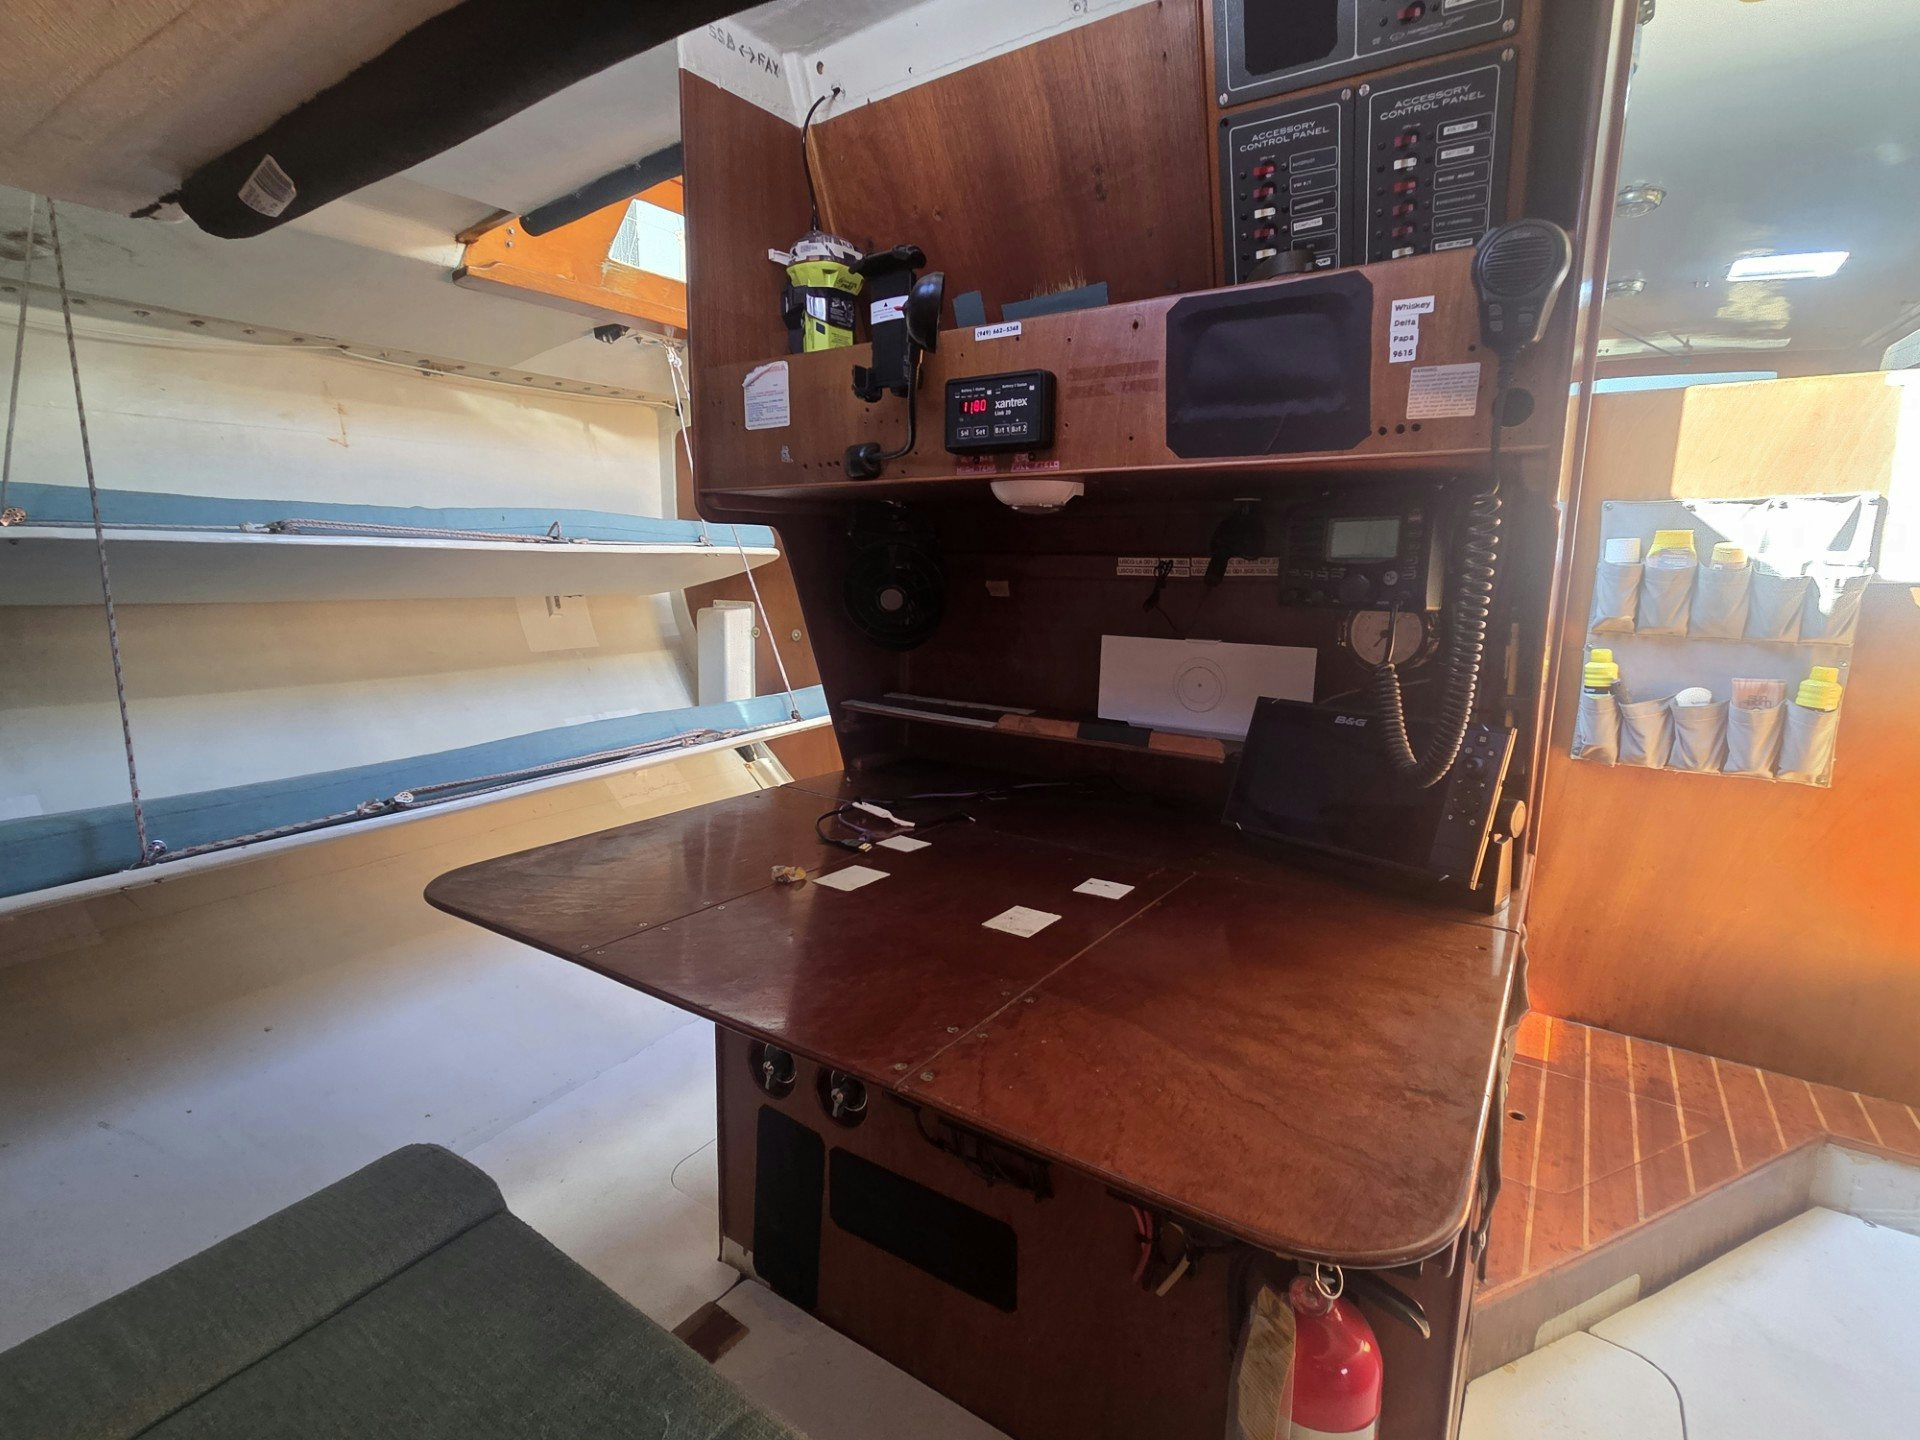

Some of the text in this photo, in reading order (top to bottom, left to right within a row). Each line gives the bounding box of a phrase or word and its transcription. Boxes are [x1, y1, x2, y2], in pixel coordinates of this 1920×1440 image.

[757, 52, 779, 78] FAX
[1395, 83, 1472, 109] ACCESSORY
[1380, 91, 1486, 120] CONTROL PANEL
[1251, 121, 1316, 142] ACCESSORY
[1240, 126, 1330, 152] CONTROL PANEL
[1394, 301, 1431, 311] Whiskey
[1394, 319, 1416, 327] Delta
[1393, 335, 1414, 343] Papa
[1392, 349, 1413, 357] 9615
[994, 398, 1028, 409] xantrex
[1334, 715, 1368, 727] B&G
